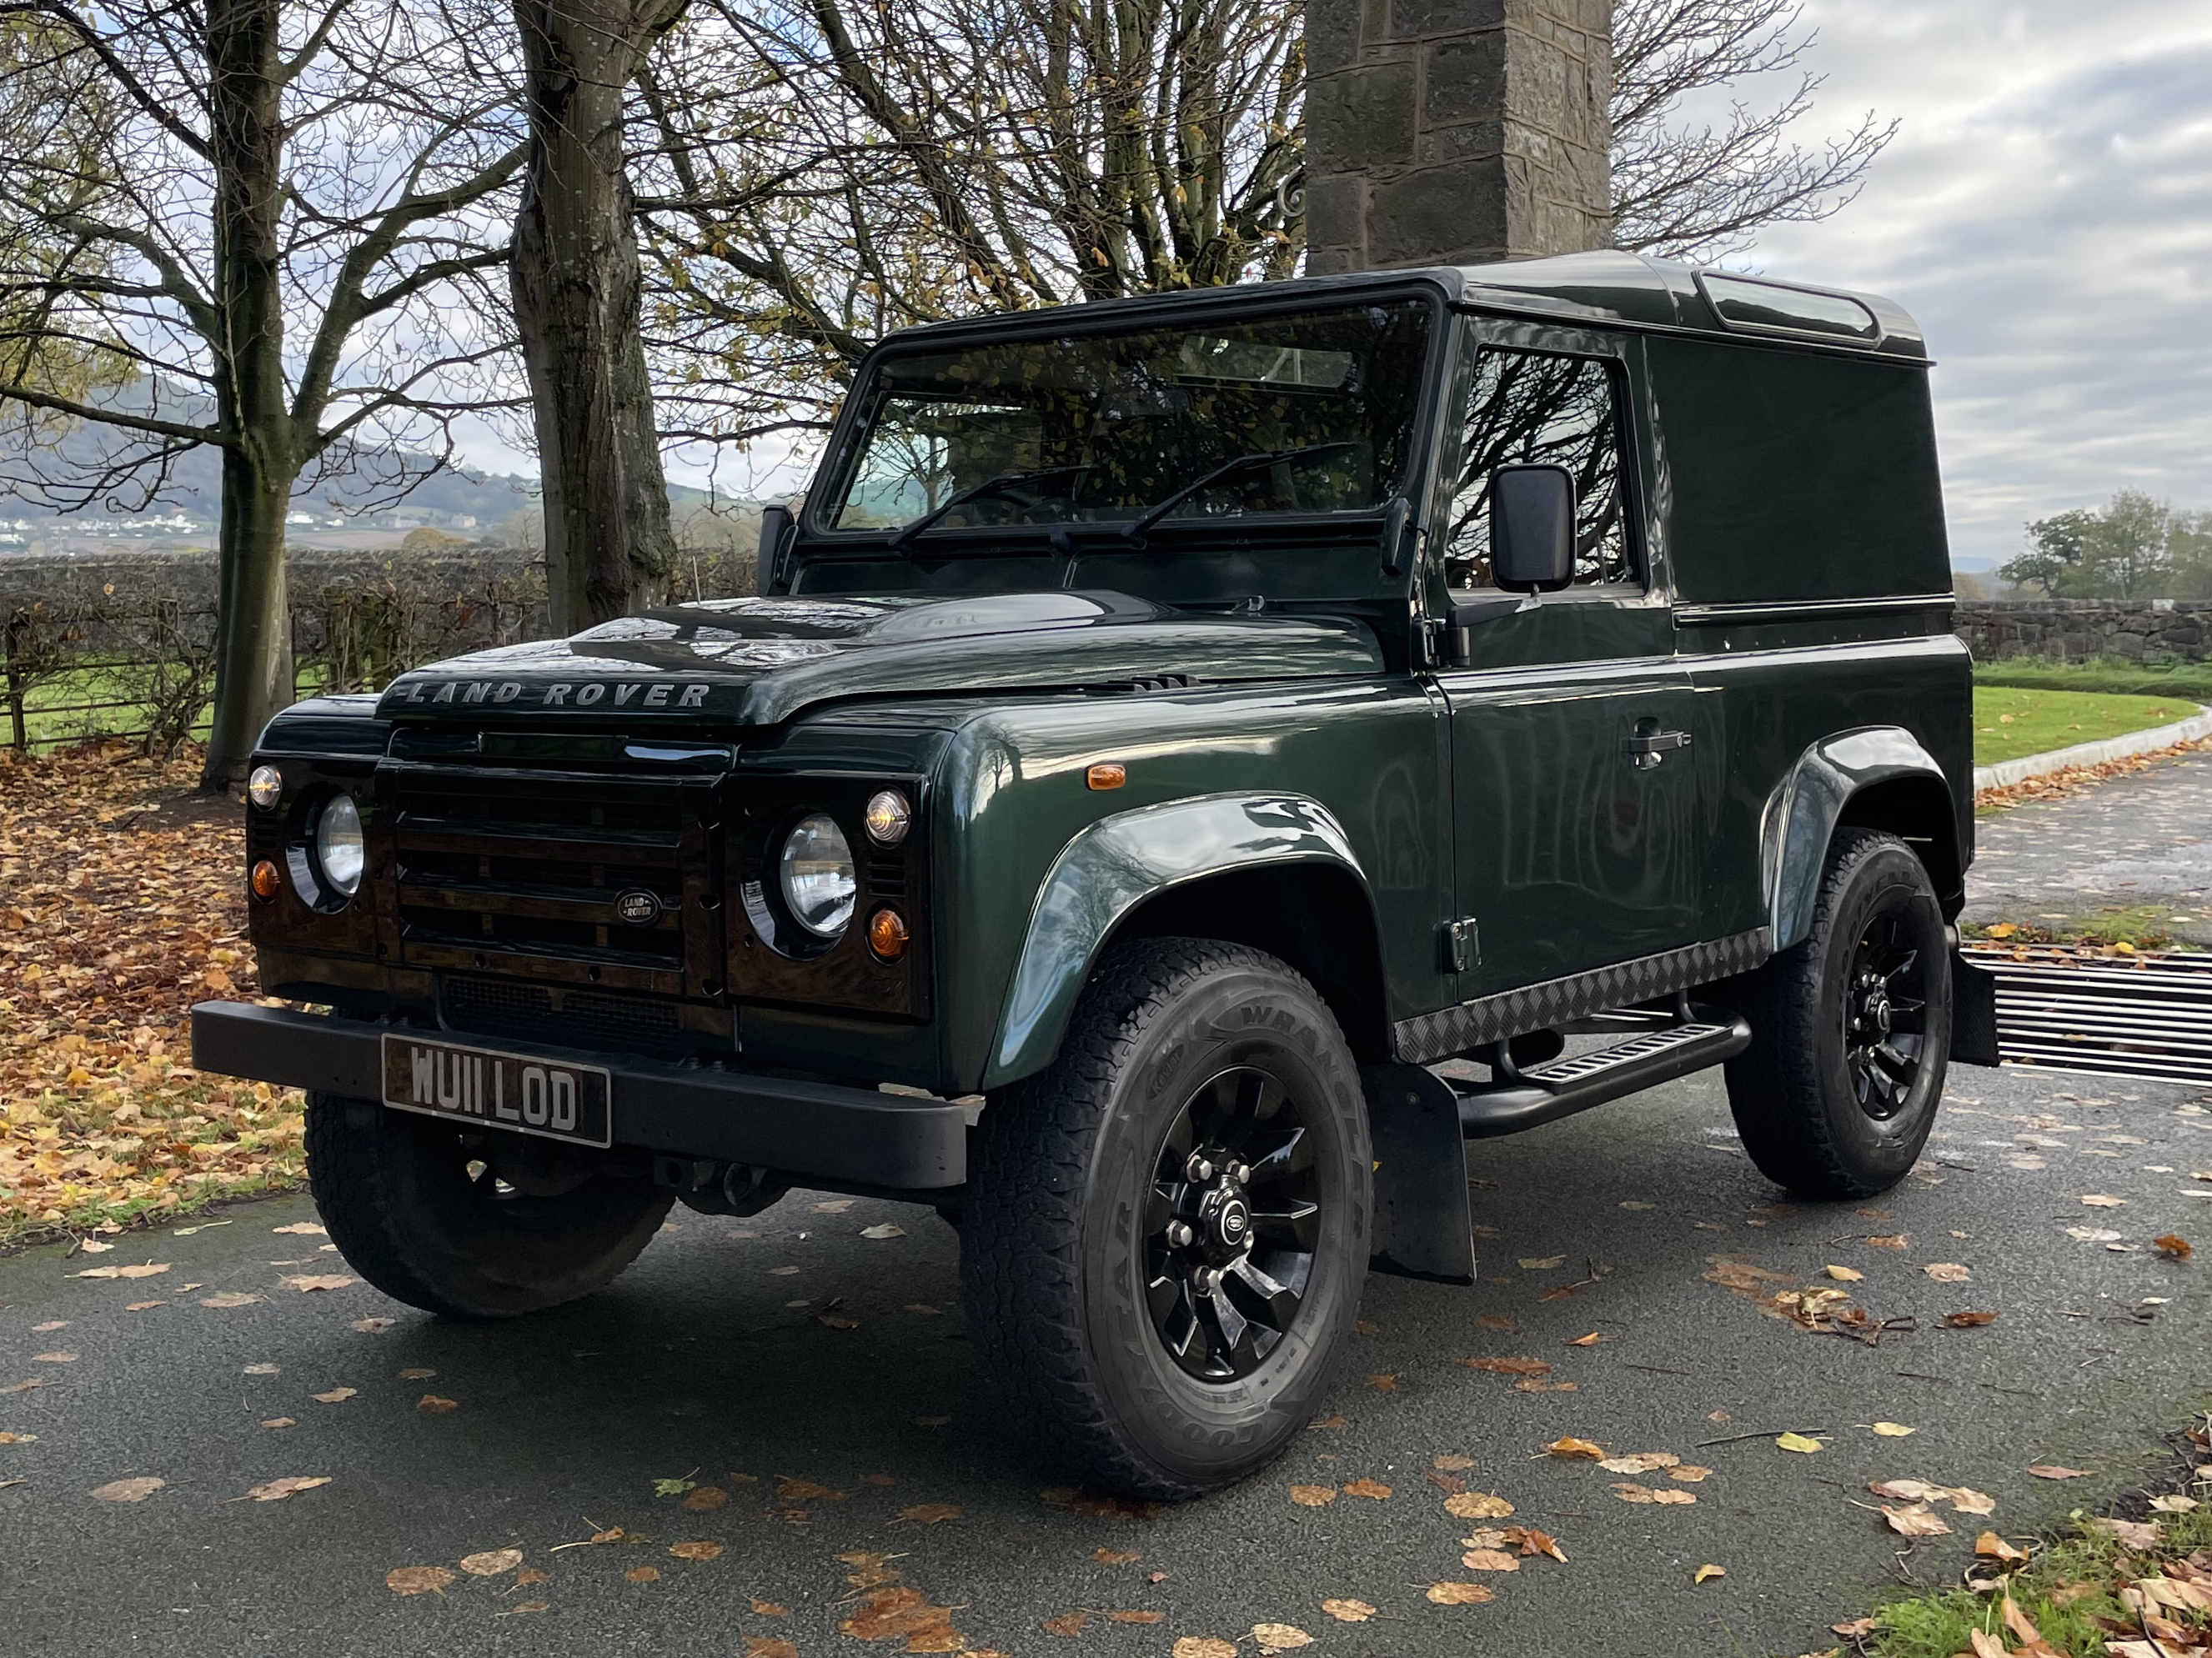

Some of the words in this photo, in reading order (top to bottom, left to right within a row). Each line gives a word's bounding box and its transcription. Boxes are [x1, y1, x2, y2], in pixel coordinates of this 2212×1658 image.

[405, 682, 522, 704] LAND
[542, 683, 710, 707] ROVER
[1239, 1005, 1365, 1241] WRANGLER
